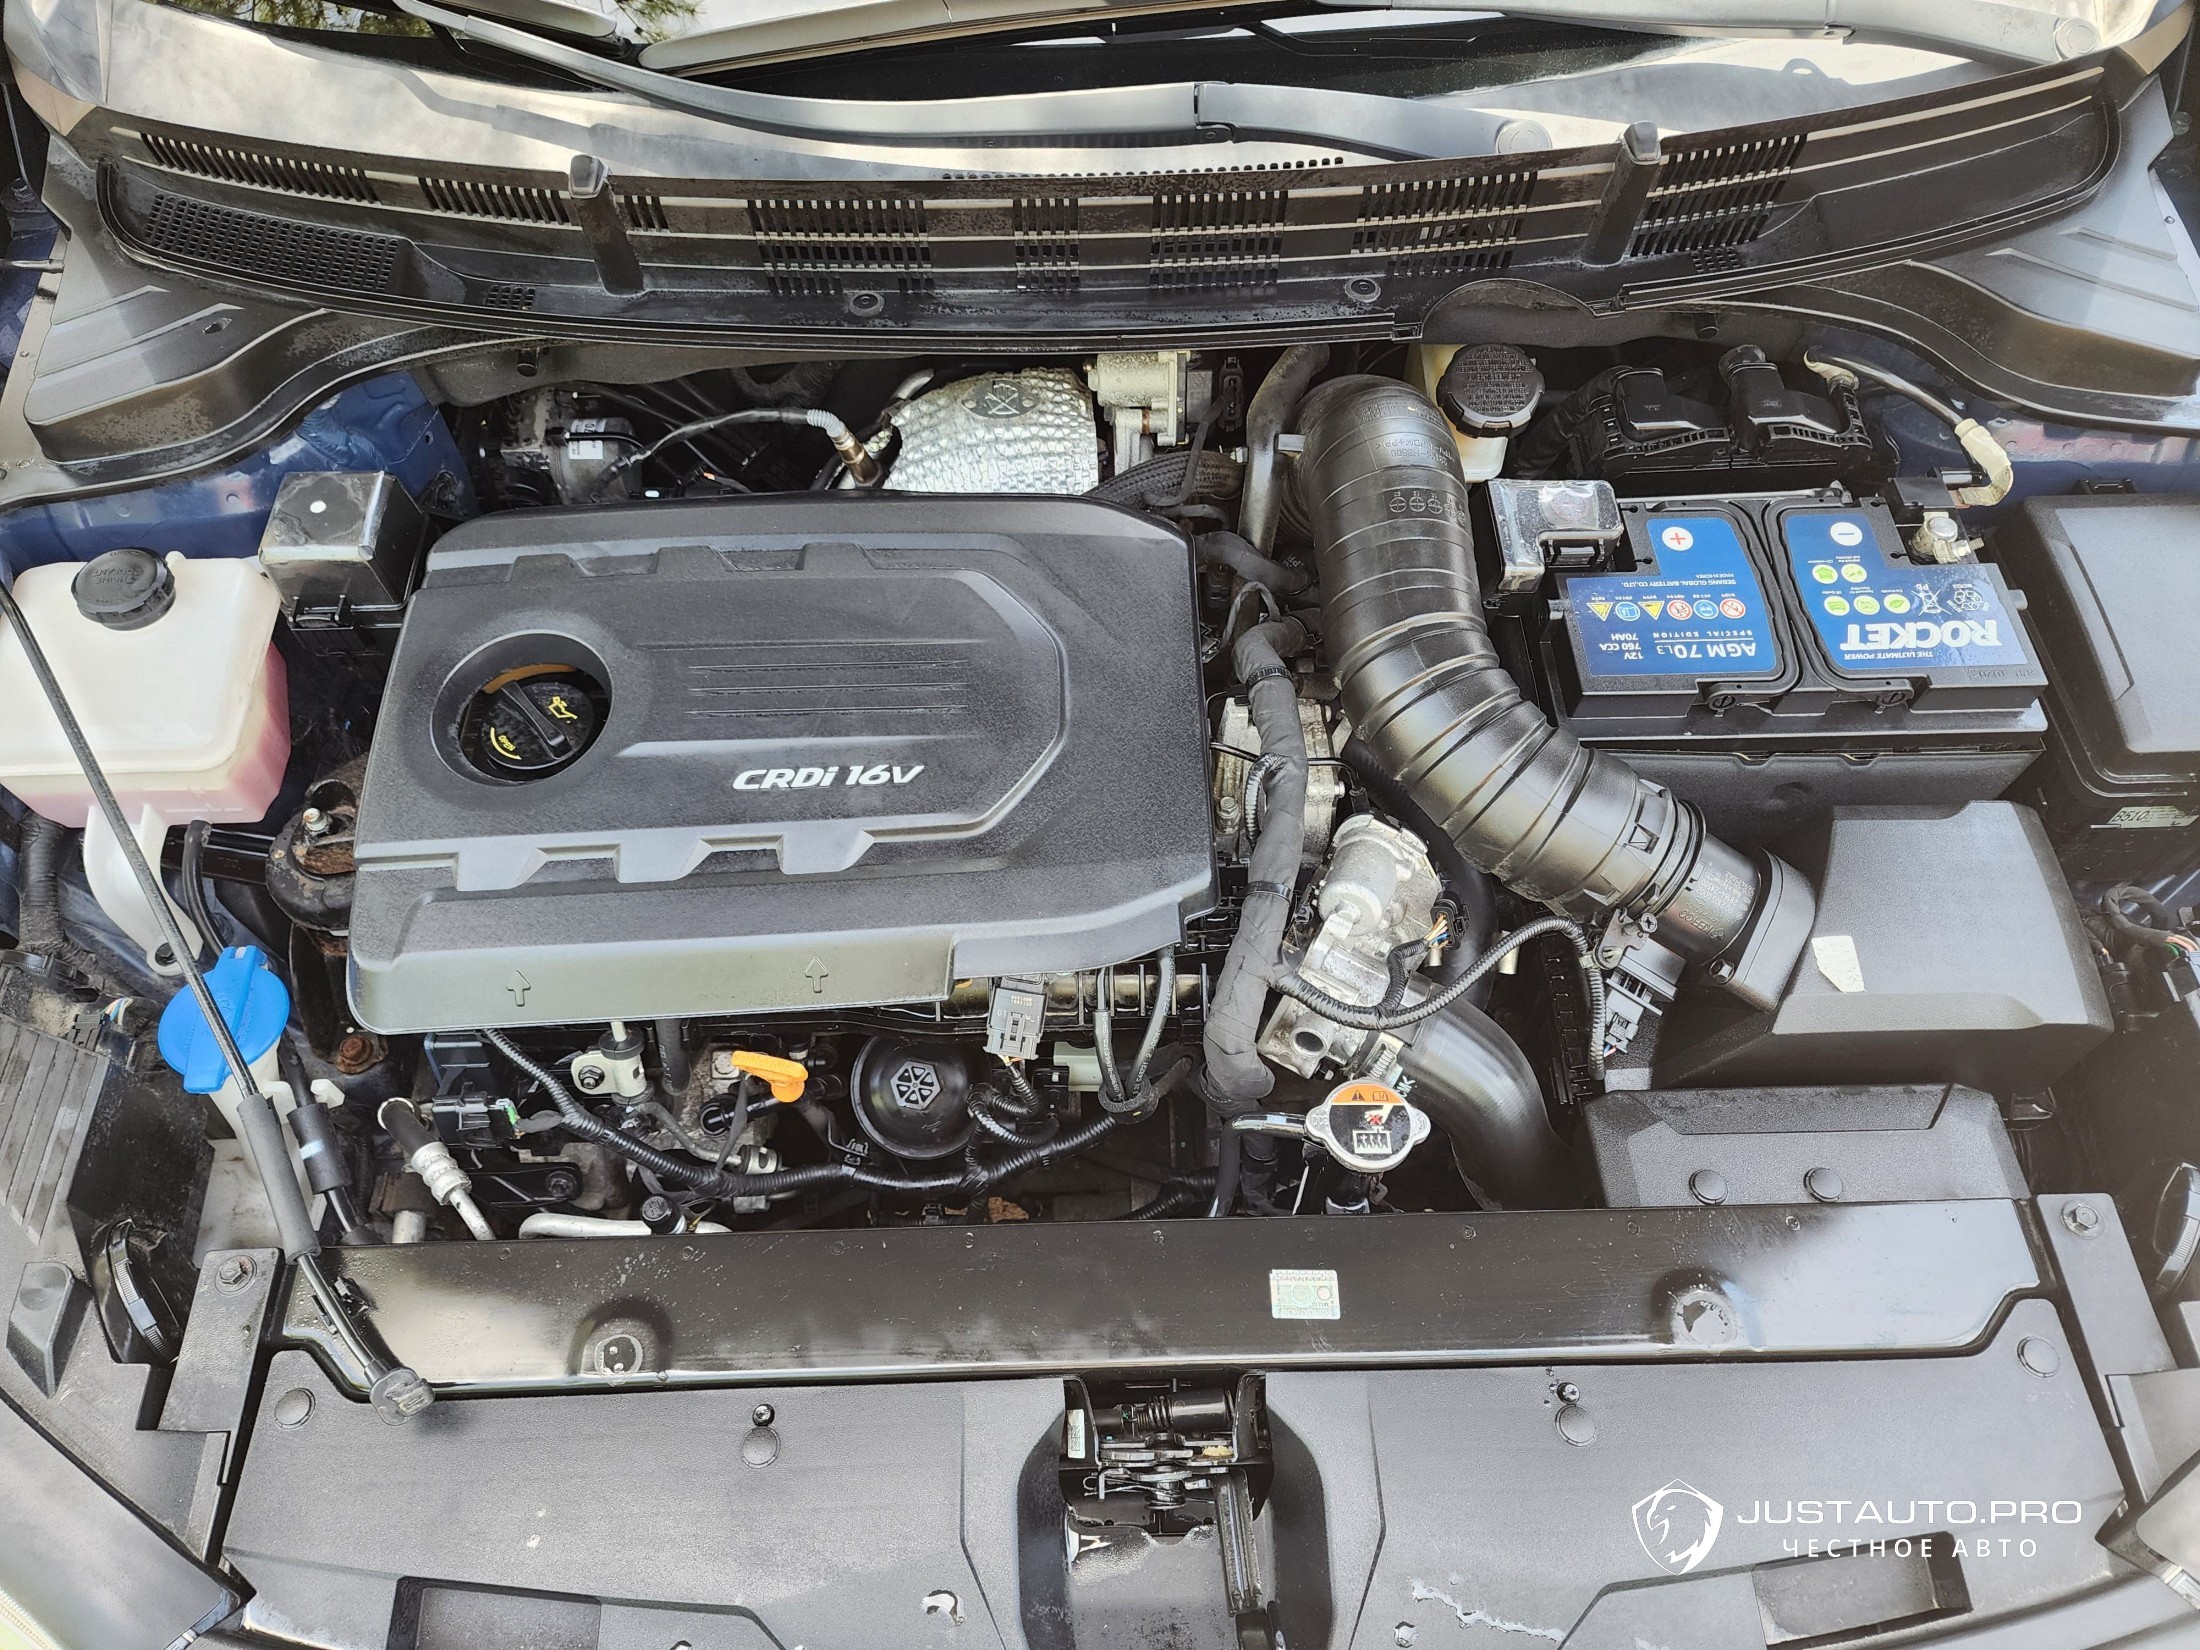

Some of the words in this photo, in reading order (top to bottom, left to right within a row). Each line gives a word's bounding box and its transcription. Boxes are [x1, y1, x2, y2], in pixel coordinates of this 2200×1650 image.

[1915, 583, 1930, 591] Pb
[1653, 631, 1699, 639] EDITION
[1840, 620, 2003, 650] ROCKET
[1599, 643, 1620, 651] CCA
[1621, 642, 1642, 651] 760
[1705, 643, 1757, 658] AGM
[1624, 651, 1644, 660] 12V
[1844, 652, 1875, 660] POWER
[1876, 651, 1915, 659] ULTIMATE
[1916, 650, 1933, 658] THE
[732, 766, 839, 790] CRDi
[845, 764, 925, 786] 16V
